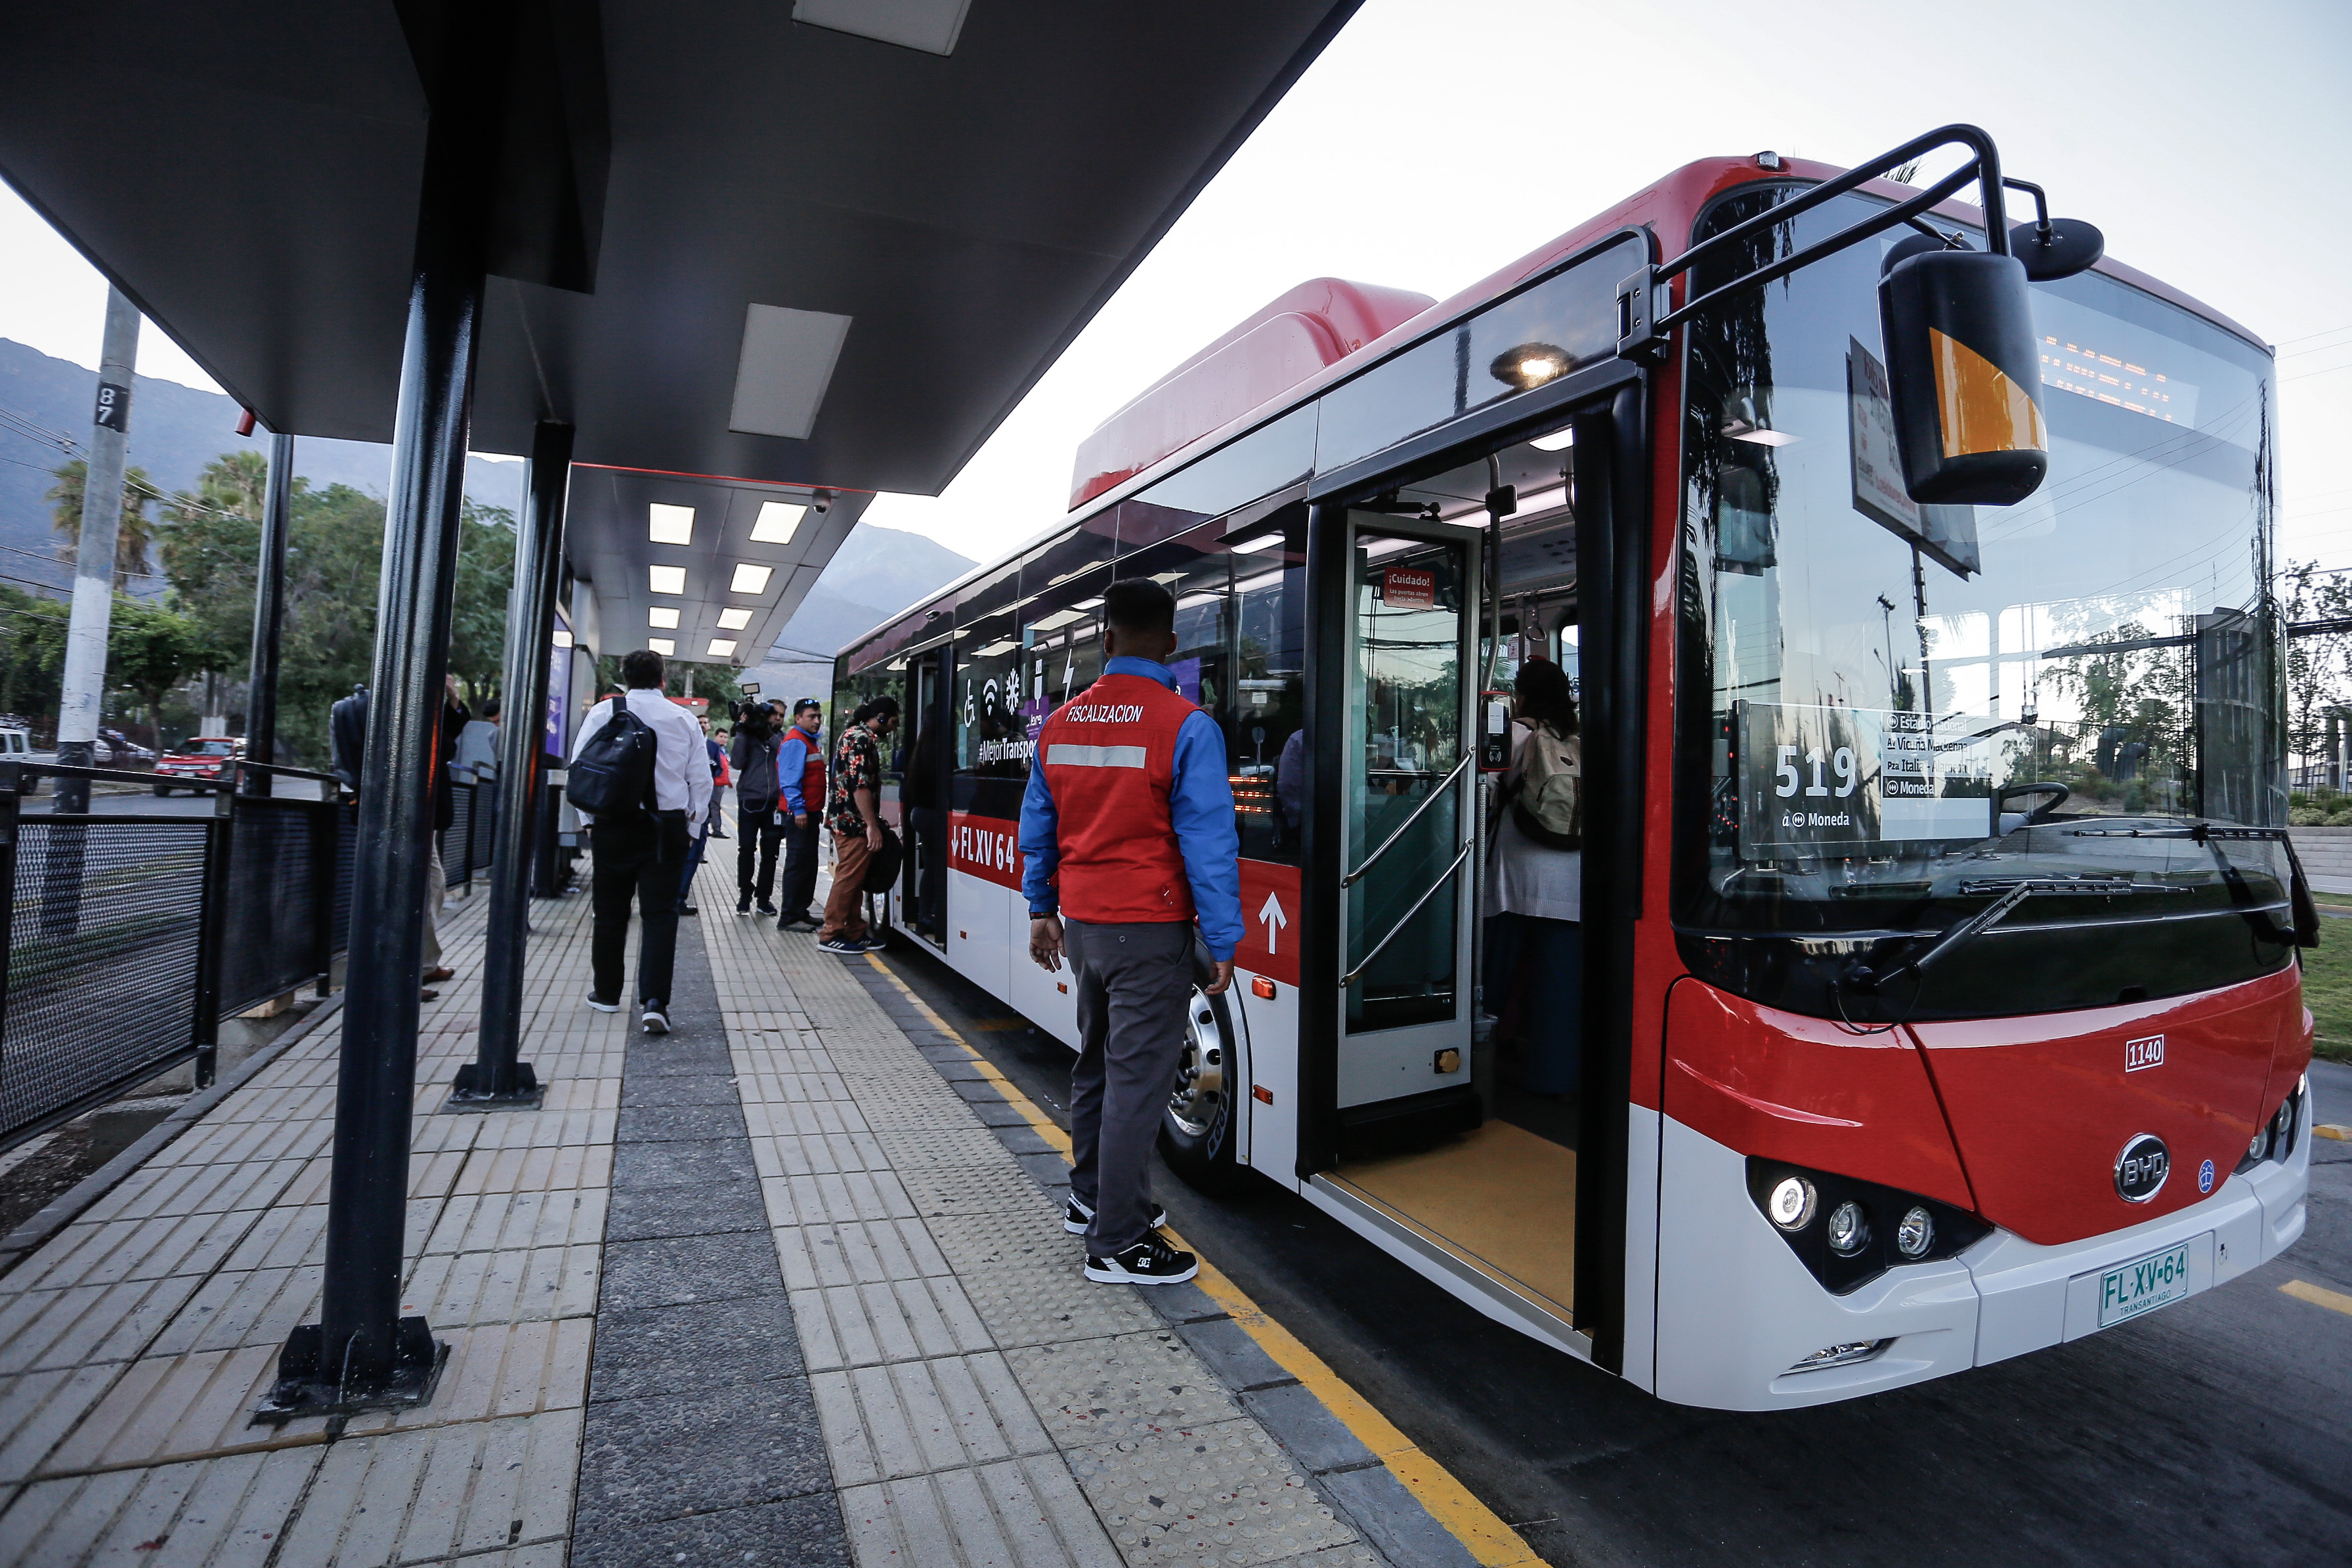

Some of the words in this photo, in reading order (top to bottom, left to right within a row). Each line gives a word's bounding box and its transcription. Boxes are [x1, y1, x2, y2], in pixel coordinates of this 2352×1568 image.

[1389, 574, 1430, 587] ¡Cuidado!
[1065, 704, 1144, 723] FISCALIZACION
[1900, 715, 1931, 731] Estadio
[1933, 717, 1967, 732] Nacional
[1887, 738, 1896, 748] Av
[1897, 736, 1926, 752] Vicuña
[1927, 738, 1968, 753] Mackenna
[1776, 745, 1856, 797] 519
[1887, 761, 1900, 771] Pza
[1901, 758, 1924, 773] Italia
[1900, 780, 1935, 795] Moneda
[1782, 815, 1789, 827] a
[1808, 811, 1850, 826] Moneda
[961, 826, 973, 861] FL
[975, 829, 993, 866] XV
[996, 833, 1015, 874] 64
[2129, 1040, 2162, 1067] 1140
[2123, 1152, 2164, 1187] BYD
[2120, 1289, 2171, 1316] TRANSANTIAGO
